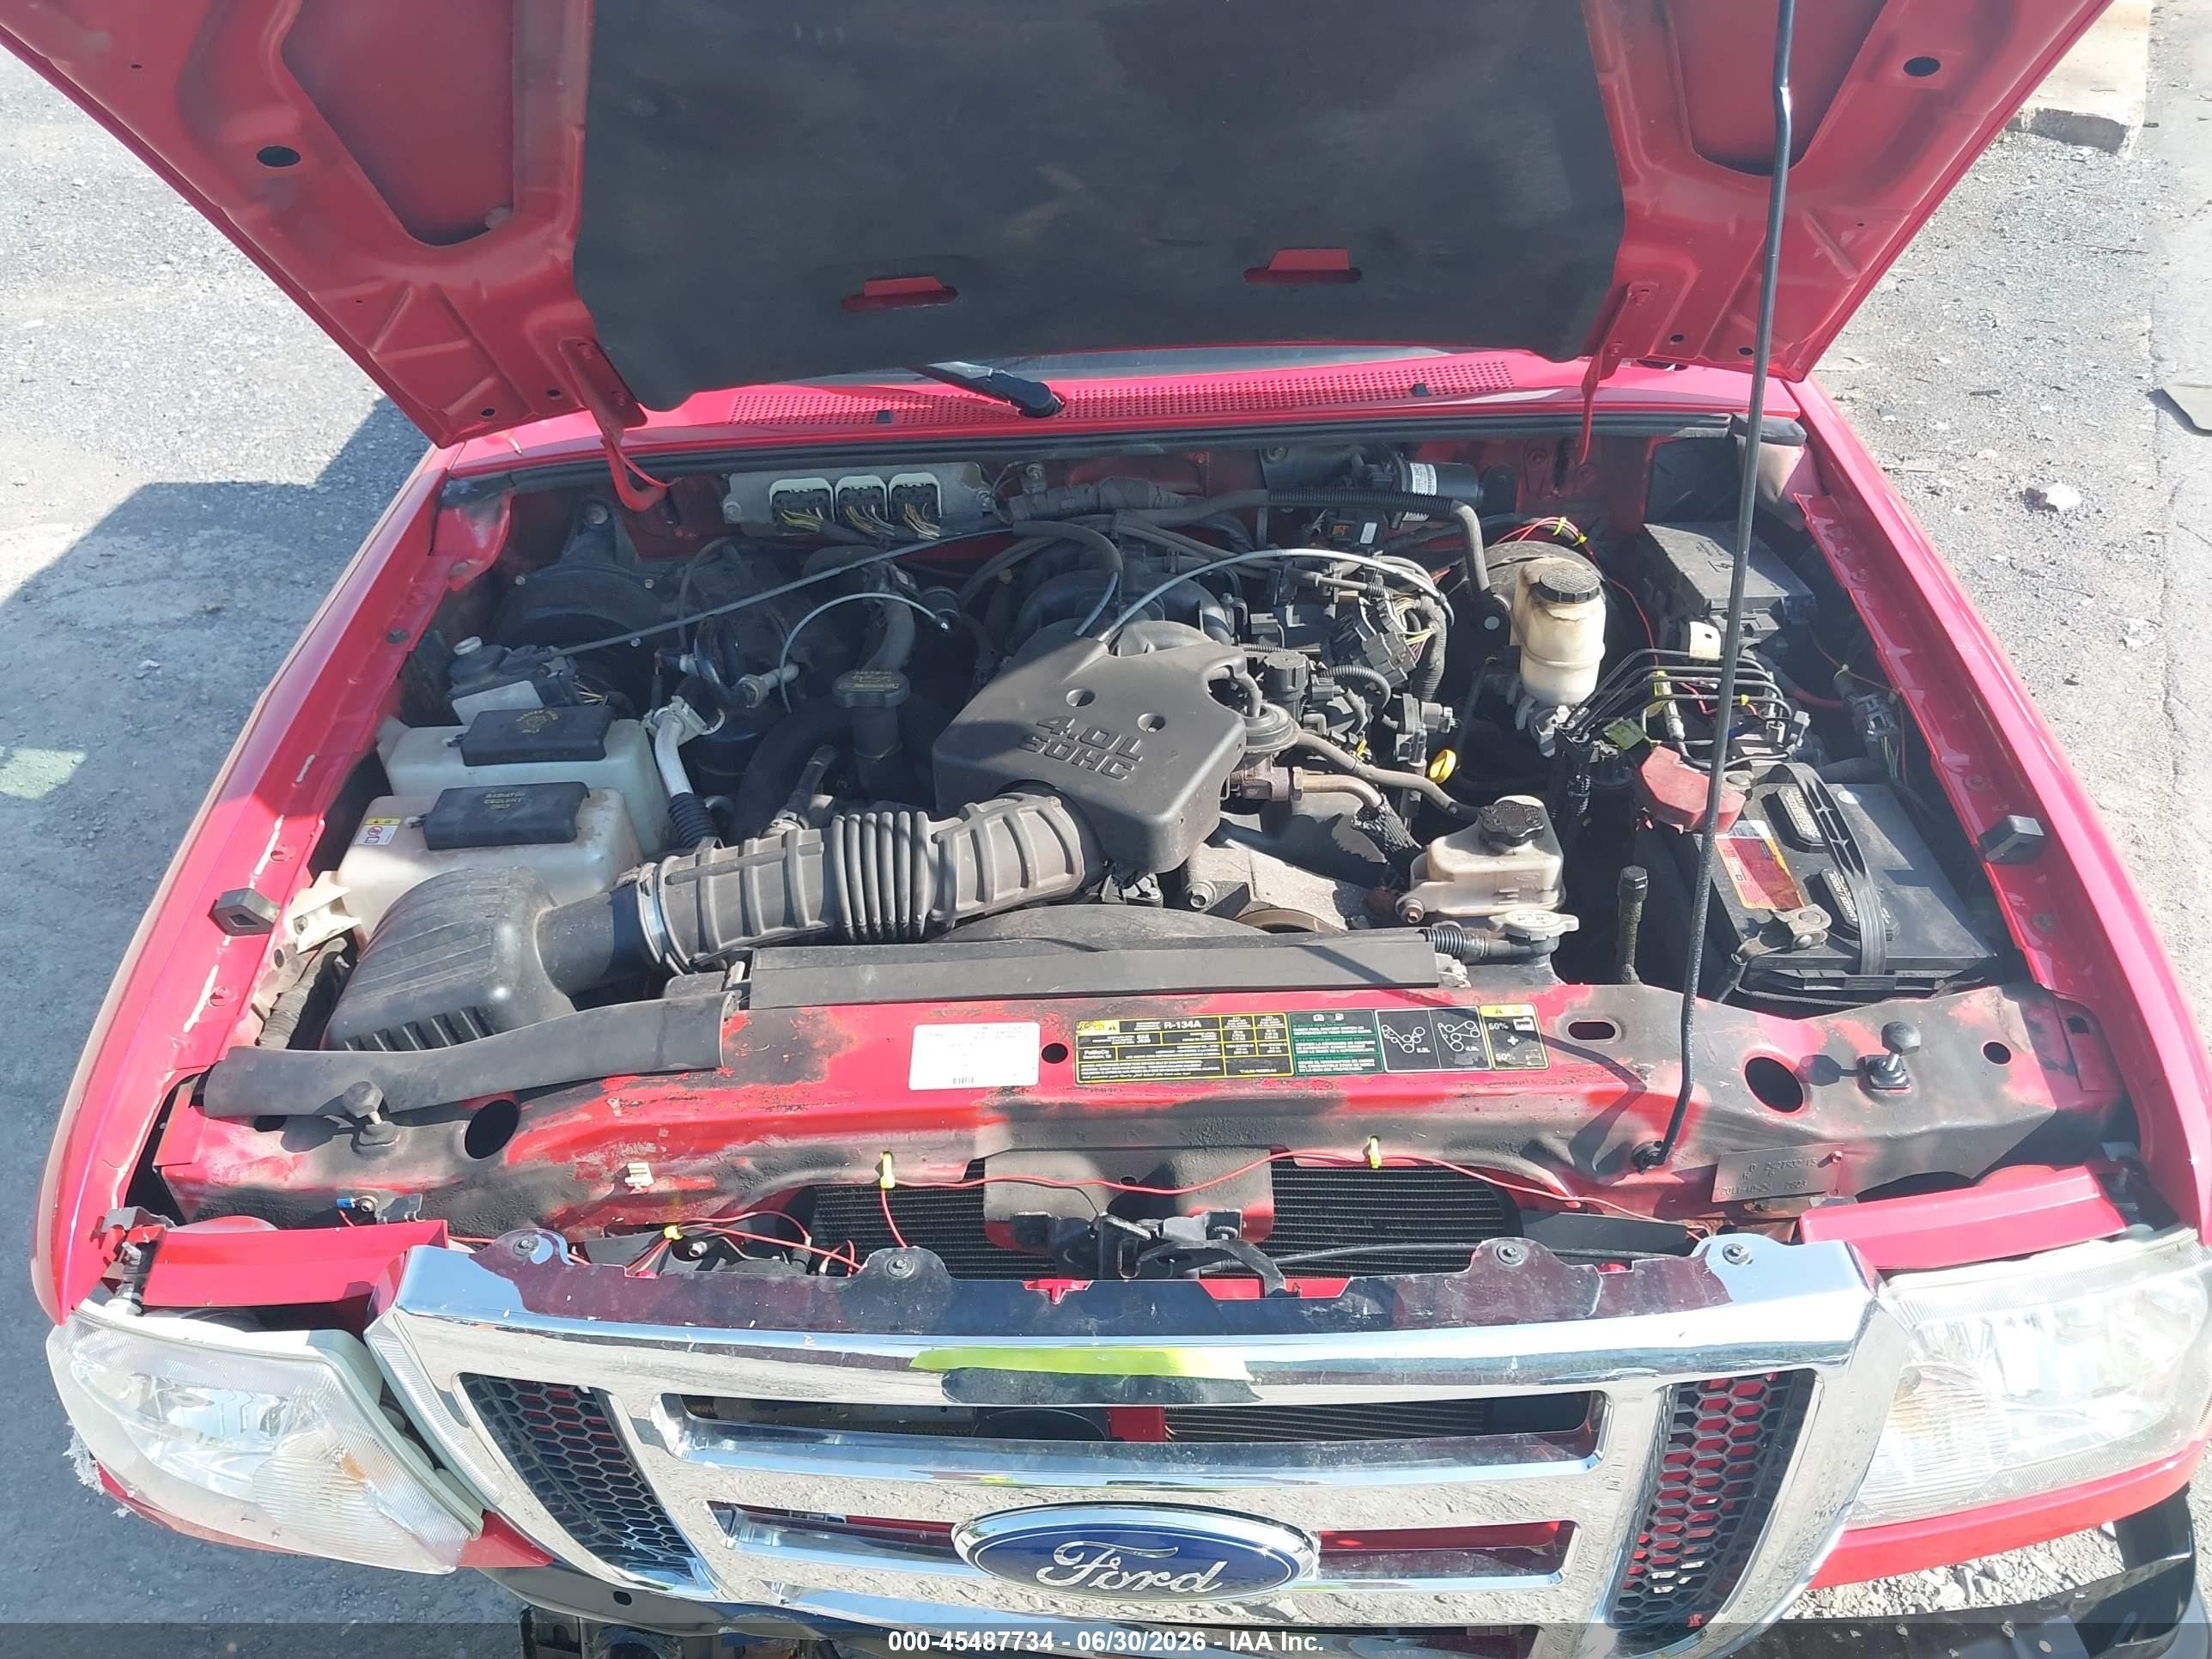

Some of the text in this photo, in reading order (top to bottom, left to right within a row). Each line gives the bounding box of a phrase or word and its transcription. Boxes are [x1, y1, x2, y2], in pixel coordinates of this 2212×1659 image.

[1018, 734, 1135, 781] SOHC
[1036, 716, 1143, 762] 4.0L
[1164, 1019, 1202, 1030] R-134A
[1036, 1540, 1228, 1593] Ford
